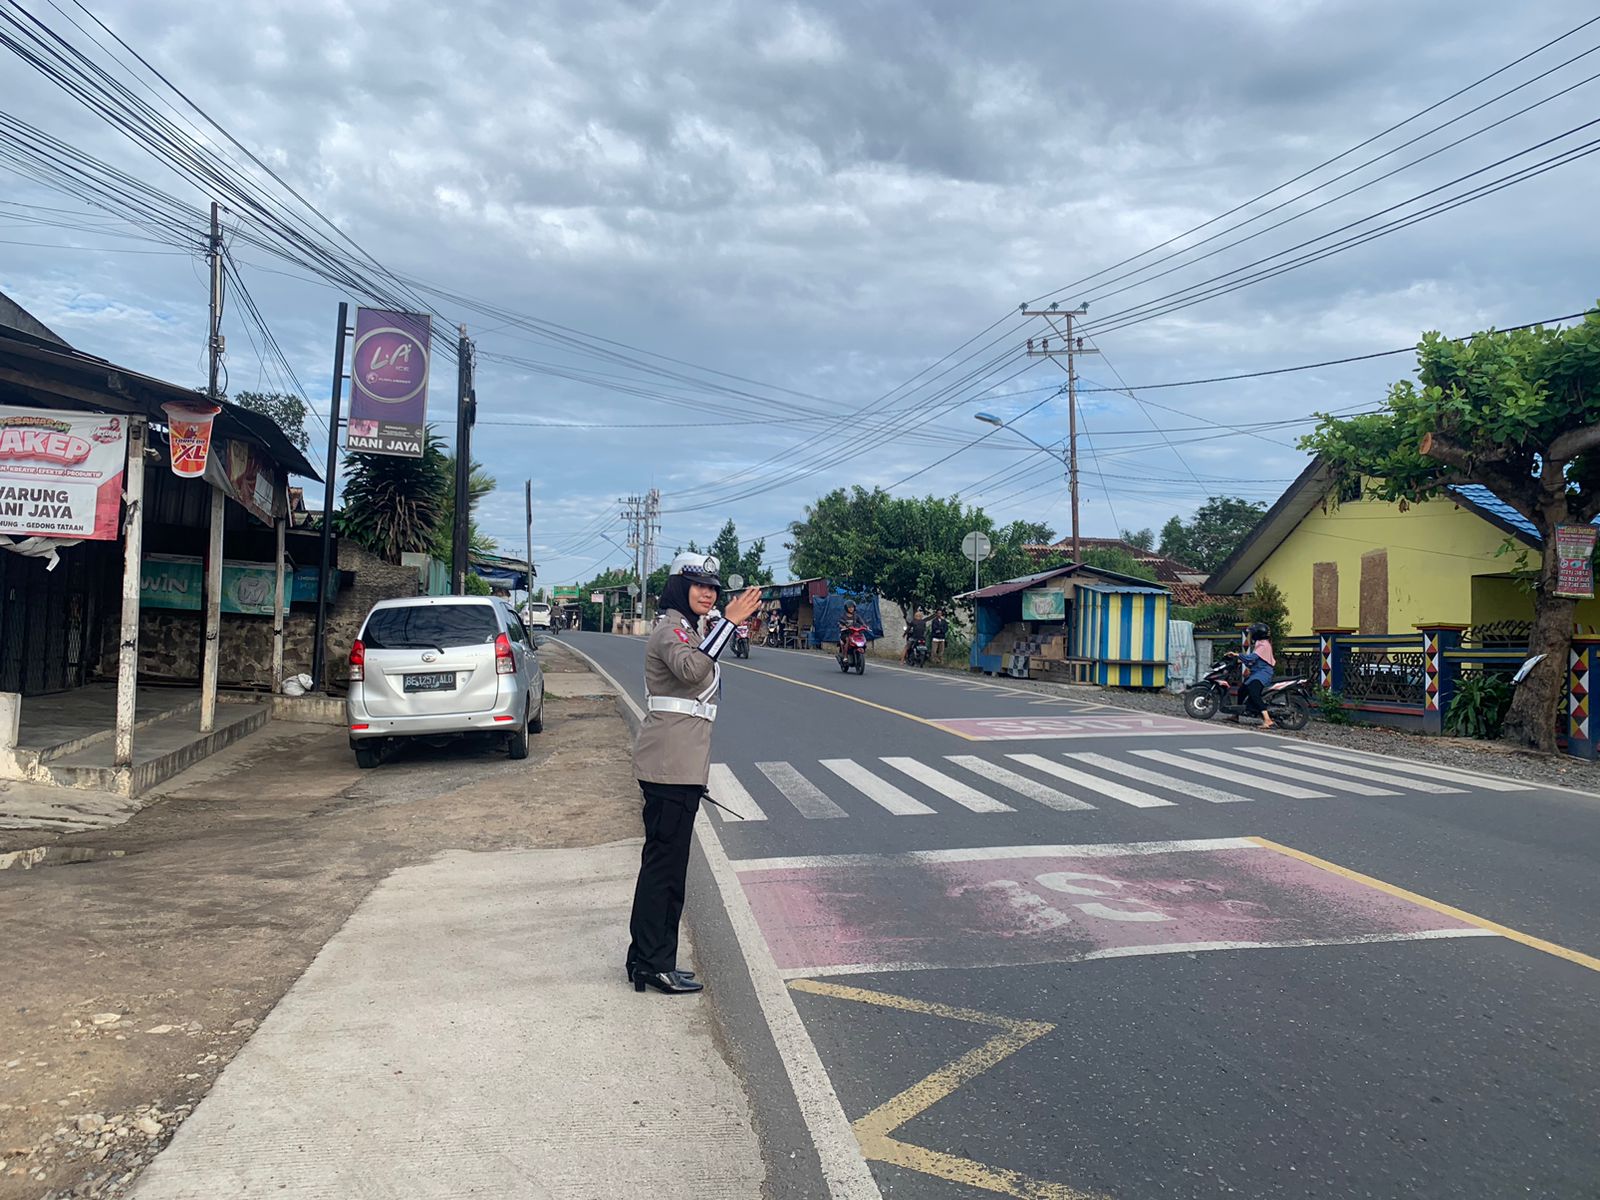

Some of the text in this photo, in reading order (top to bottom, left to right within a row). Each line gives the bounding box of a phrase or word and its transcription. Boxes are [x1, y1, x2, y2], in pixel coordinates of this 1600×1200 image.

[348, 436, 420, 452] NANI JAYA
[174, 444, 206, 464] XL
[28, 504, 73, 519] JAYA
[26, 522, 55, 530] GEDONG
[57, 524, 84, 532] TATAAN
